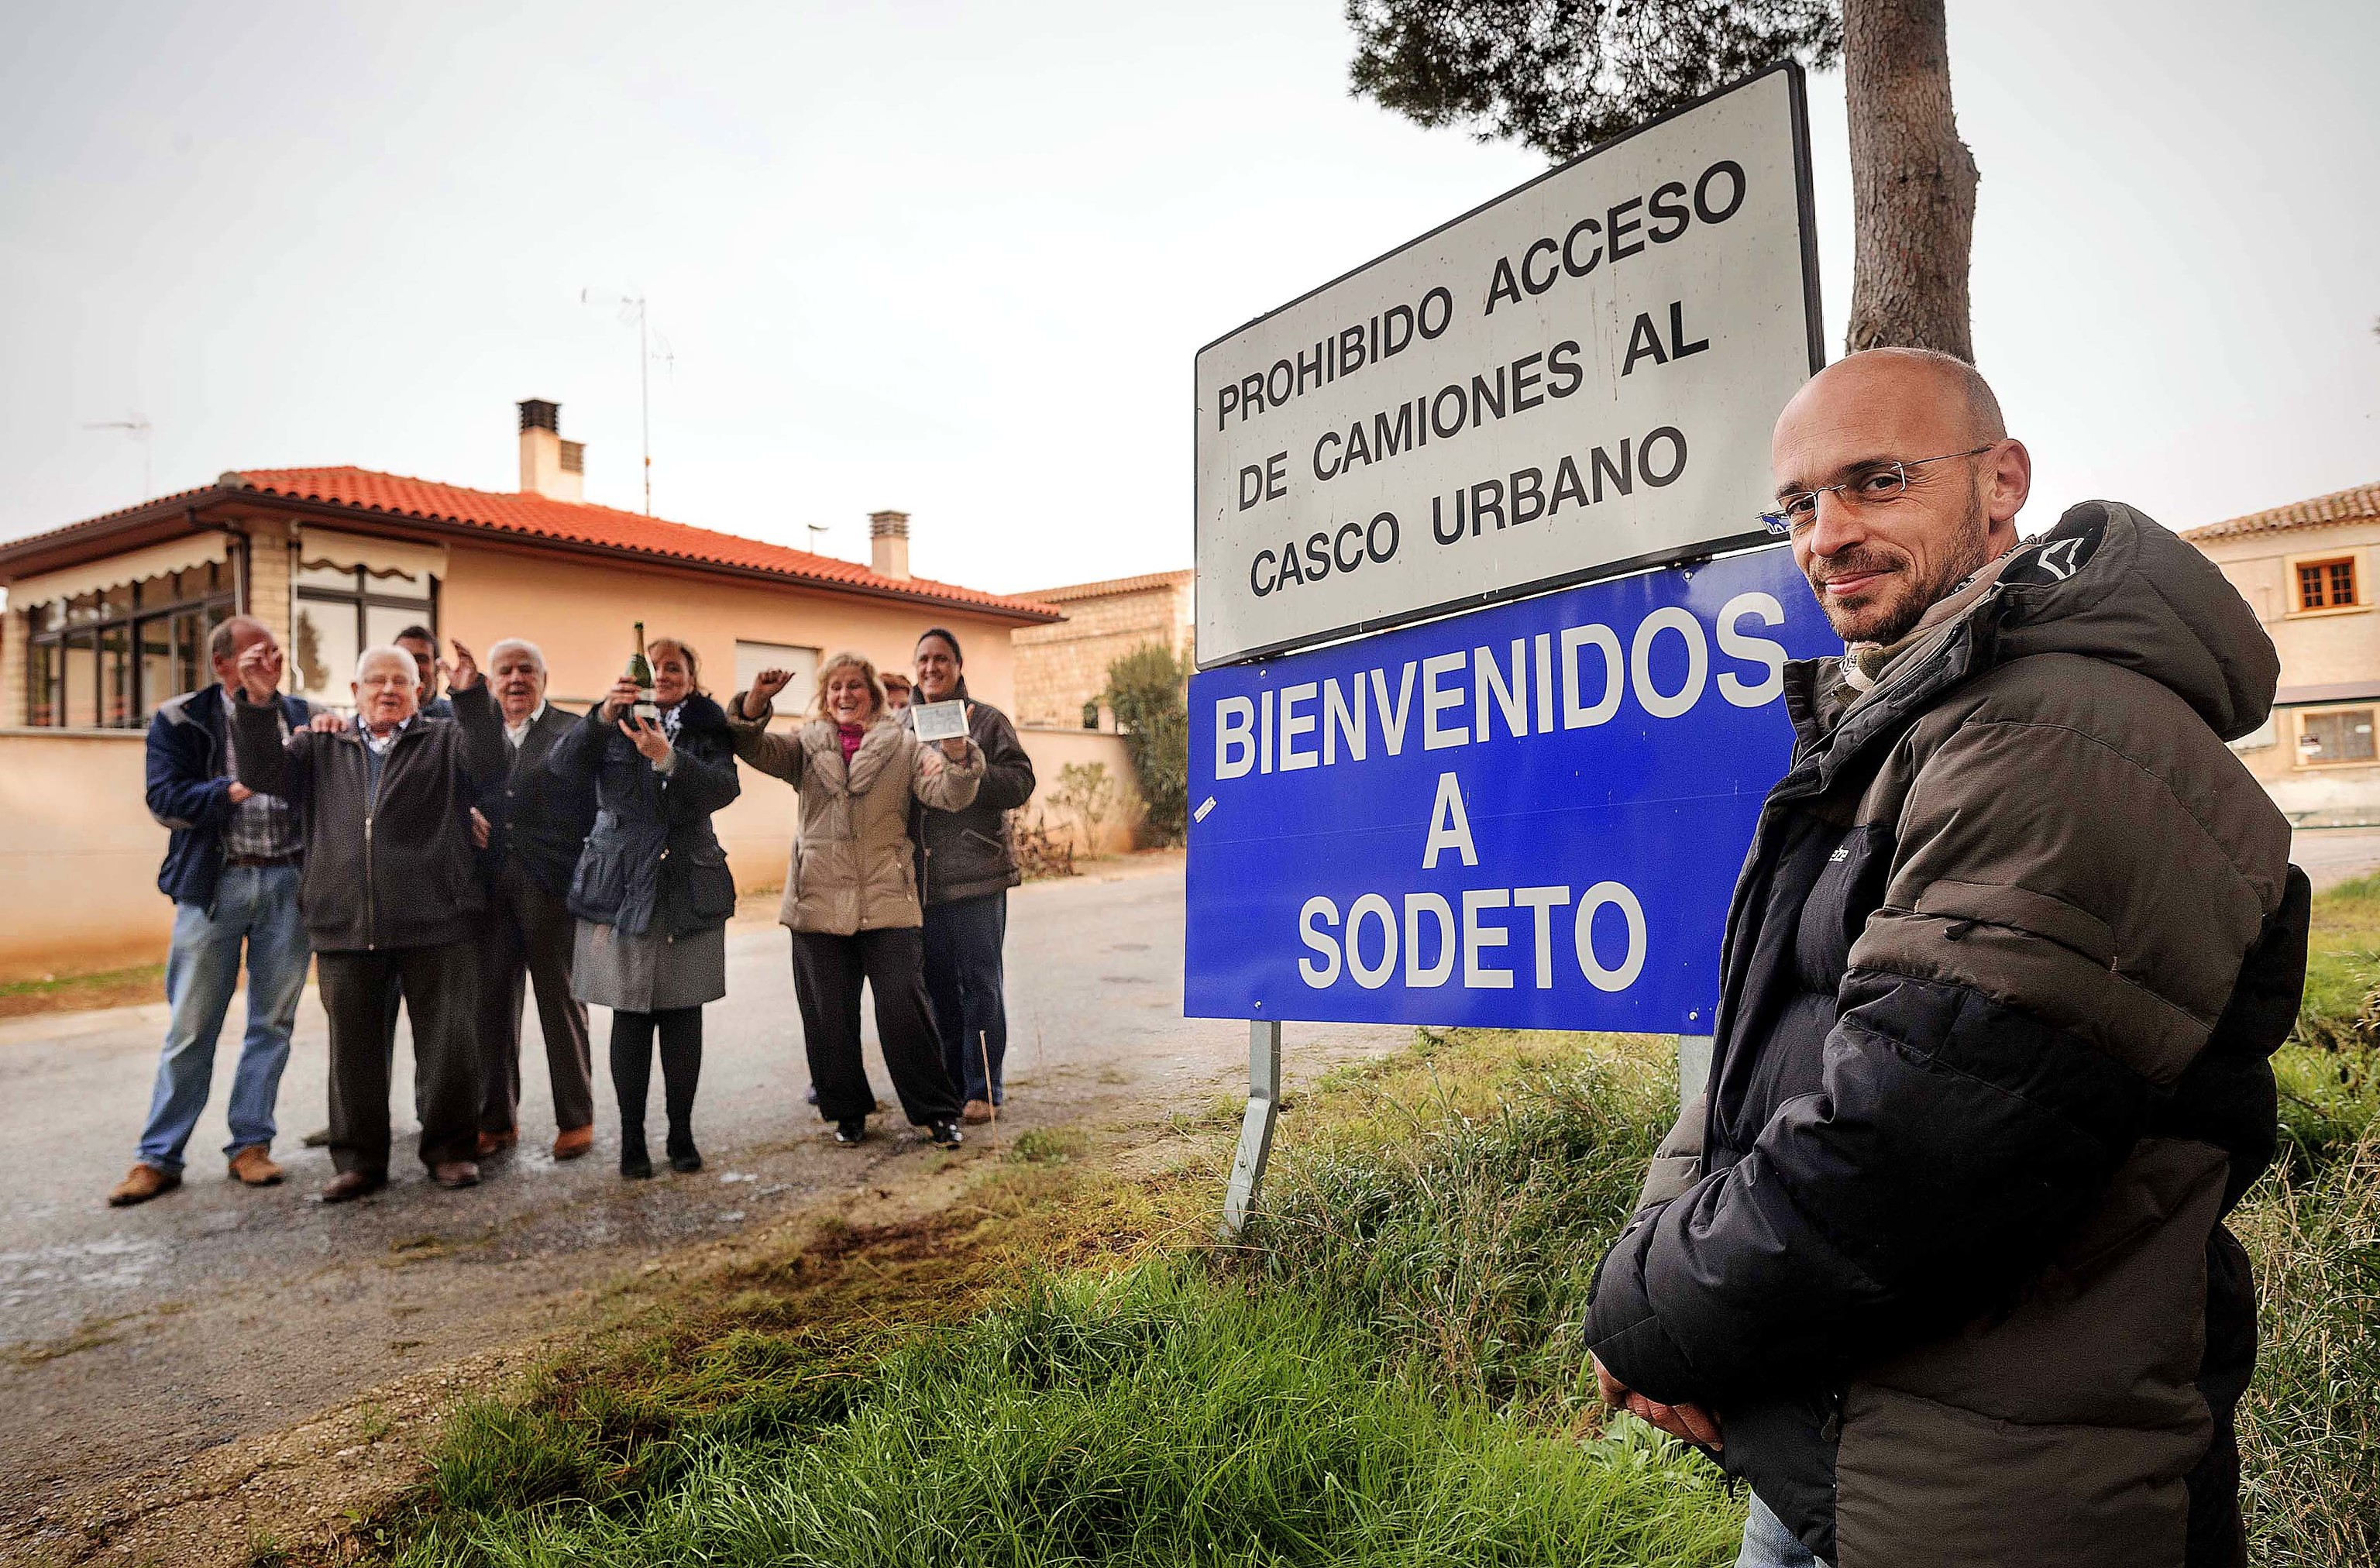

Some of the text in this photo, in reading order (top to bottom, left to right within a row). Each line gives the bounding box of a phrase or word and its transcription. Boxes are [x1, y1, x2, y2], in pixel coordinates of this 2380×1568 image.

[1219, 160, 1746, 432] PROHIBIDO ACCESO
[1240, 301, 1710, 512] DE CAMIONES AL
[1250, 426, 1687, 597] CASCO URBANO
[1216, 591, 1787, 780] BIENVENIDOS
[1422, 772, 1479, 869] A
[1298, 881, 1647, 992] SODETO
